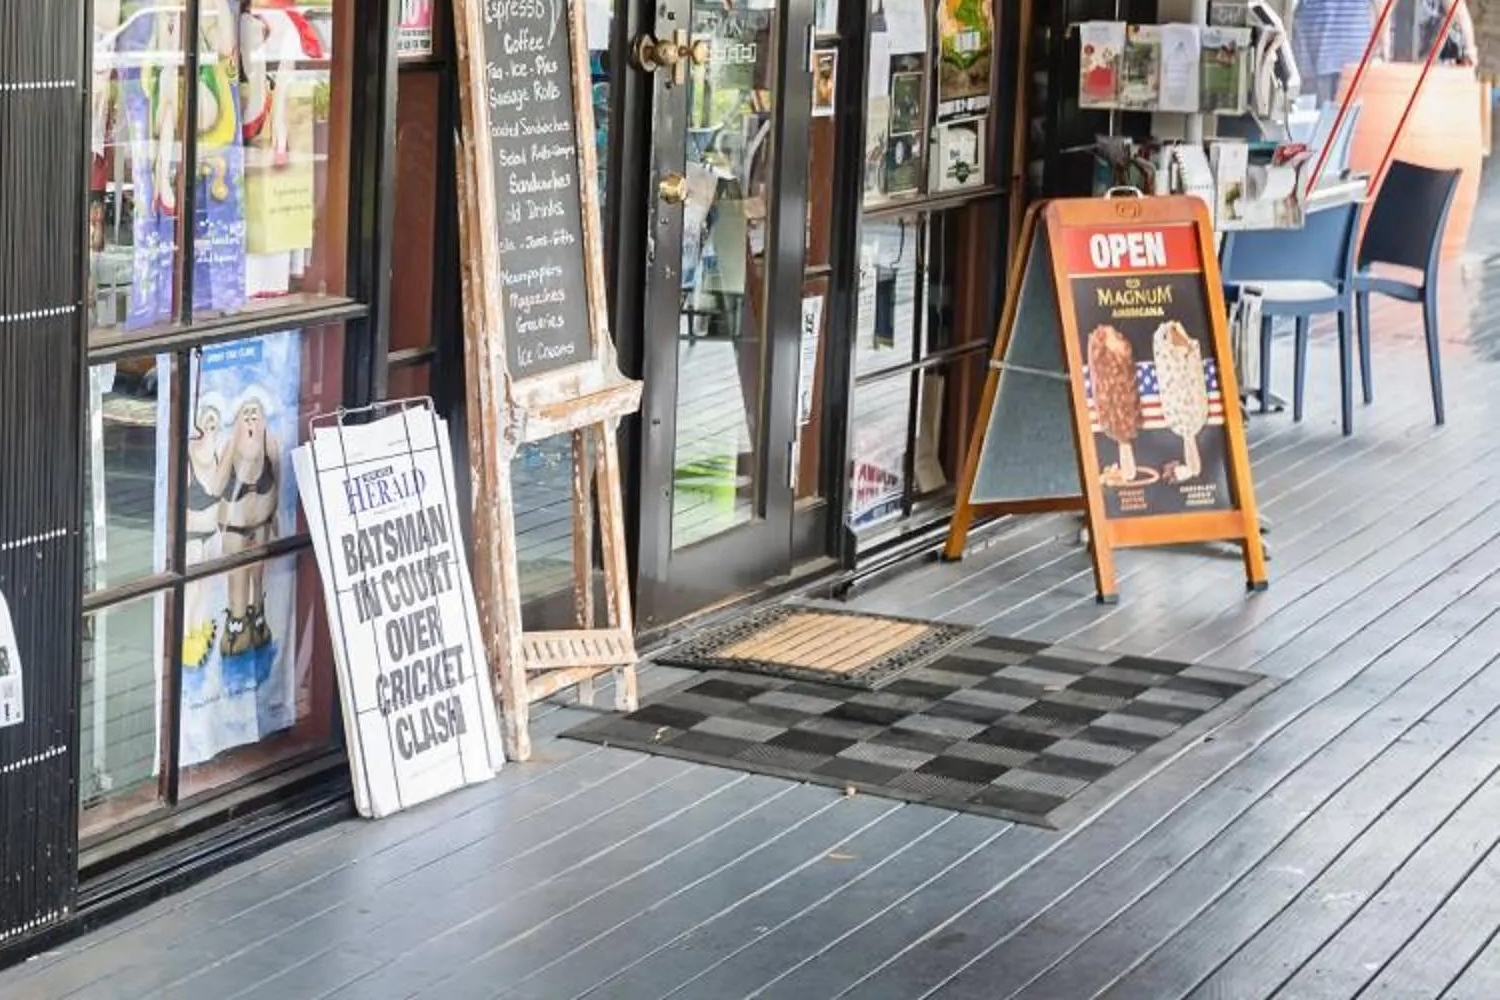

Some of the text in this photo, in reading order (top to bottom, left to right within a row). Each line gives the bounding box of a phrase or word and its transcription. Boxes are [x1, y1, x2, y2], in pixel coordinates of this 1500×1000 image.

[503, 28, 545, 55] Coffee
[533, 80, 561, 102] Rolls
[490, 120, 519, 137] oasted
[528, 198, 565, 220] Drinks
[1089, 231, 1167, 269] OPEN
[1096, 284, 1173, 307] MAGNUM
[342, 467, 427, 515] HERALD
[341, 503, 449, 577] BATSMAN
[352, 549, 453, 625] IN COURT
[385, 604, 444, 663] OVER
[375, 643, 465, 718] CRICKET
[395, 694, 467, 761] CLASH
